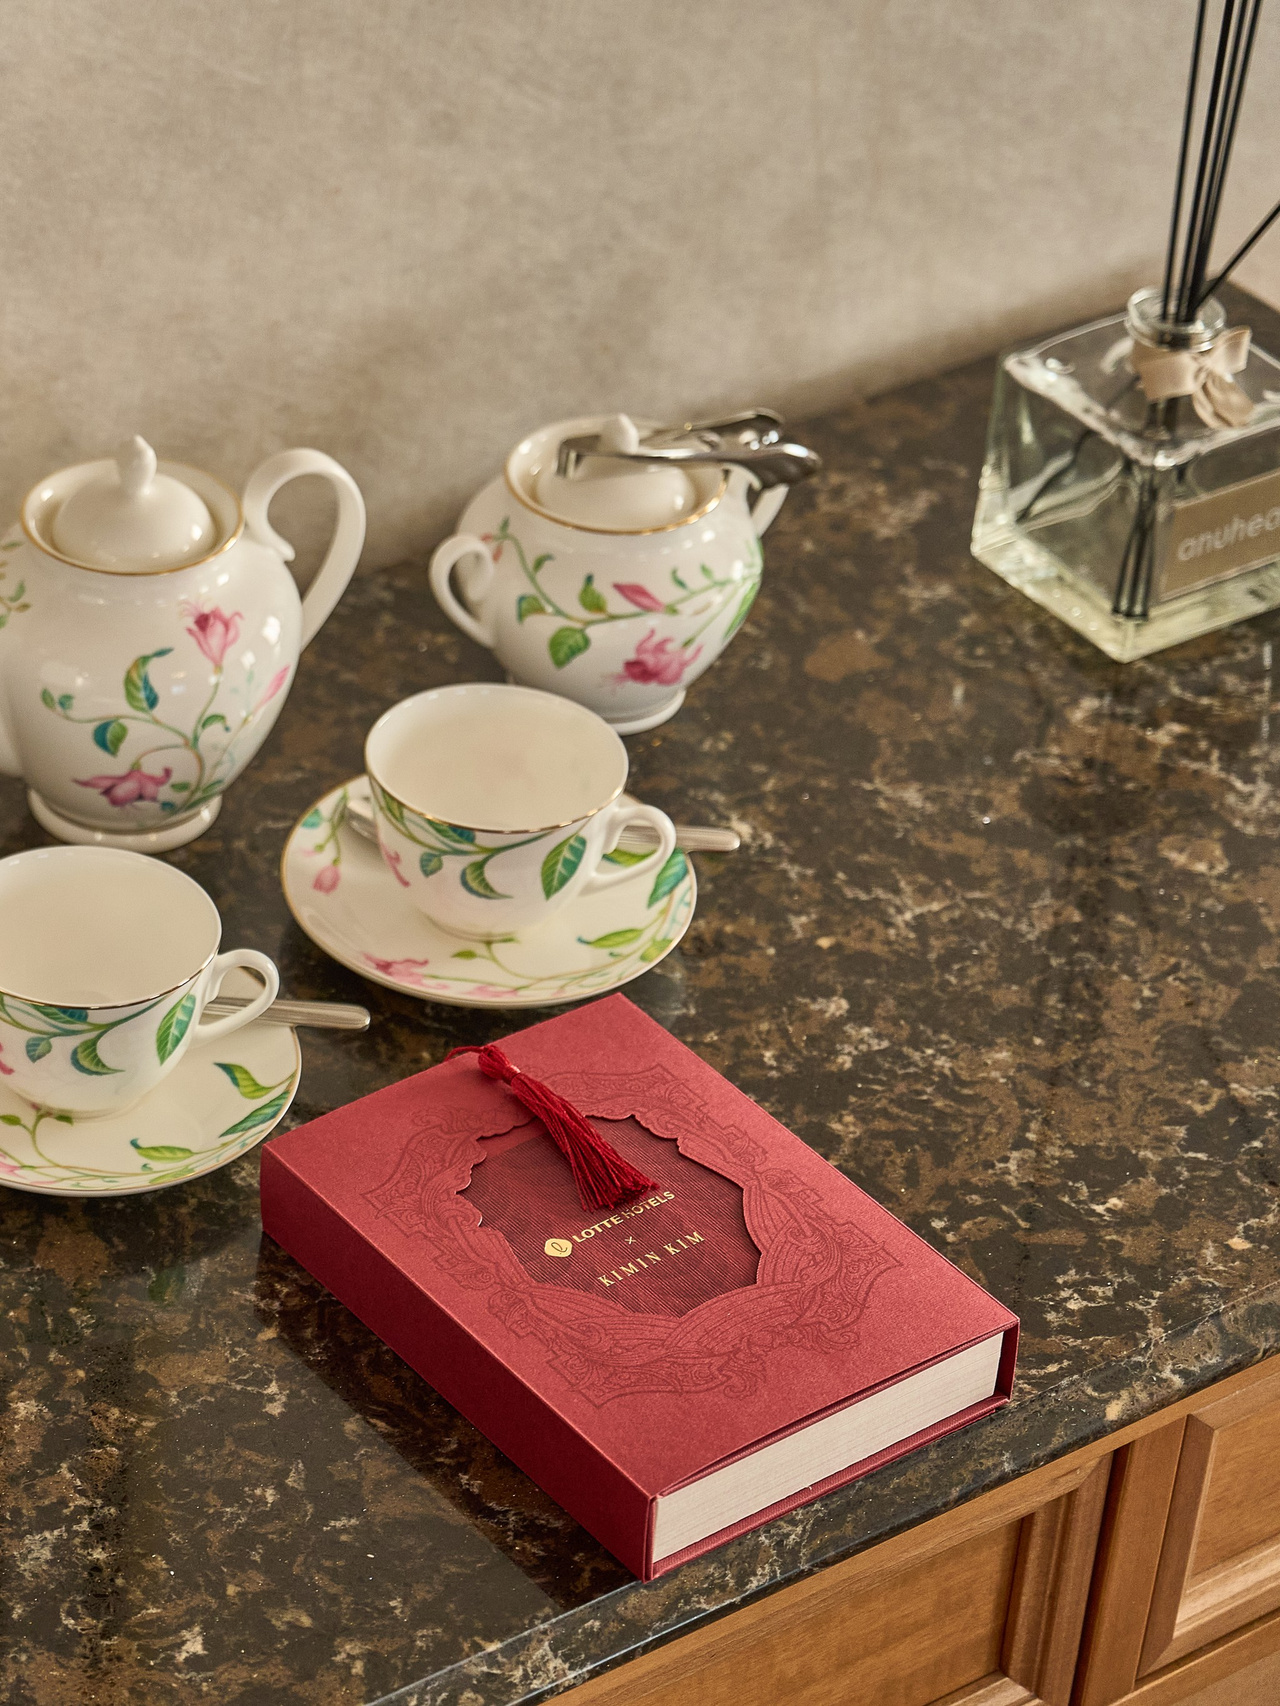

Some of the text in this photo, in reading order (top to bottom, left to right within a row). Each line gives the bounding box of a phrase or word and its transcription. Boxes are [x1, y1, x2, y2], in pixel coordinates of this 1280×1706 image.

[572, 1191, 676, 1243] LOTTE HOTELS
[597, 1231, 705, 1288] KIMIN KIM
